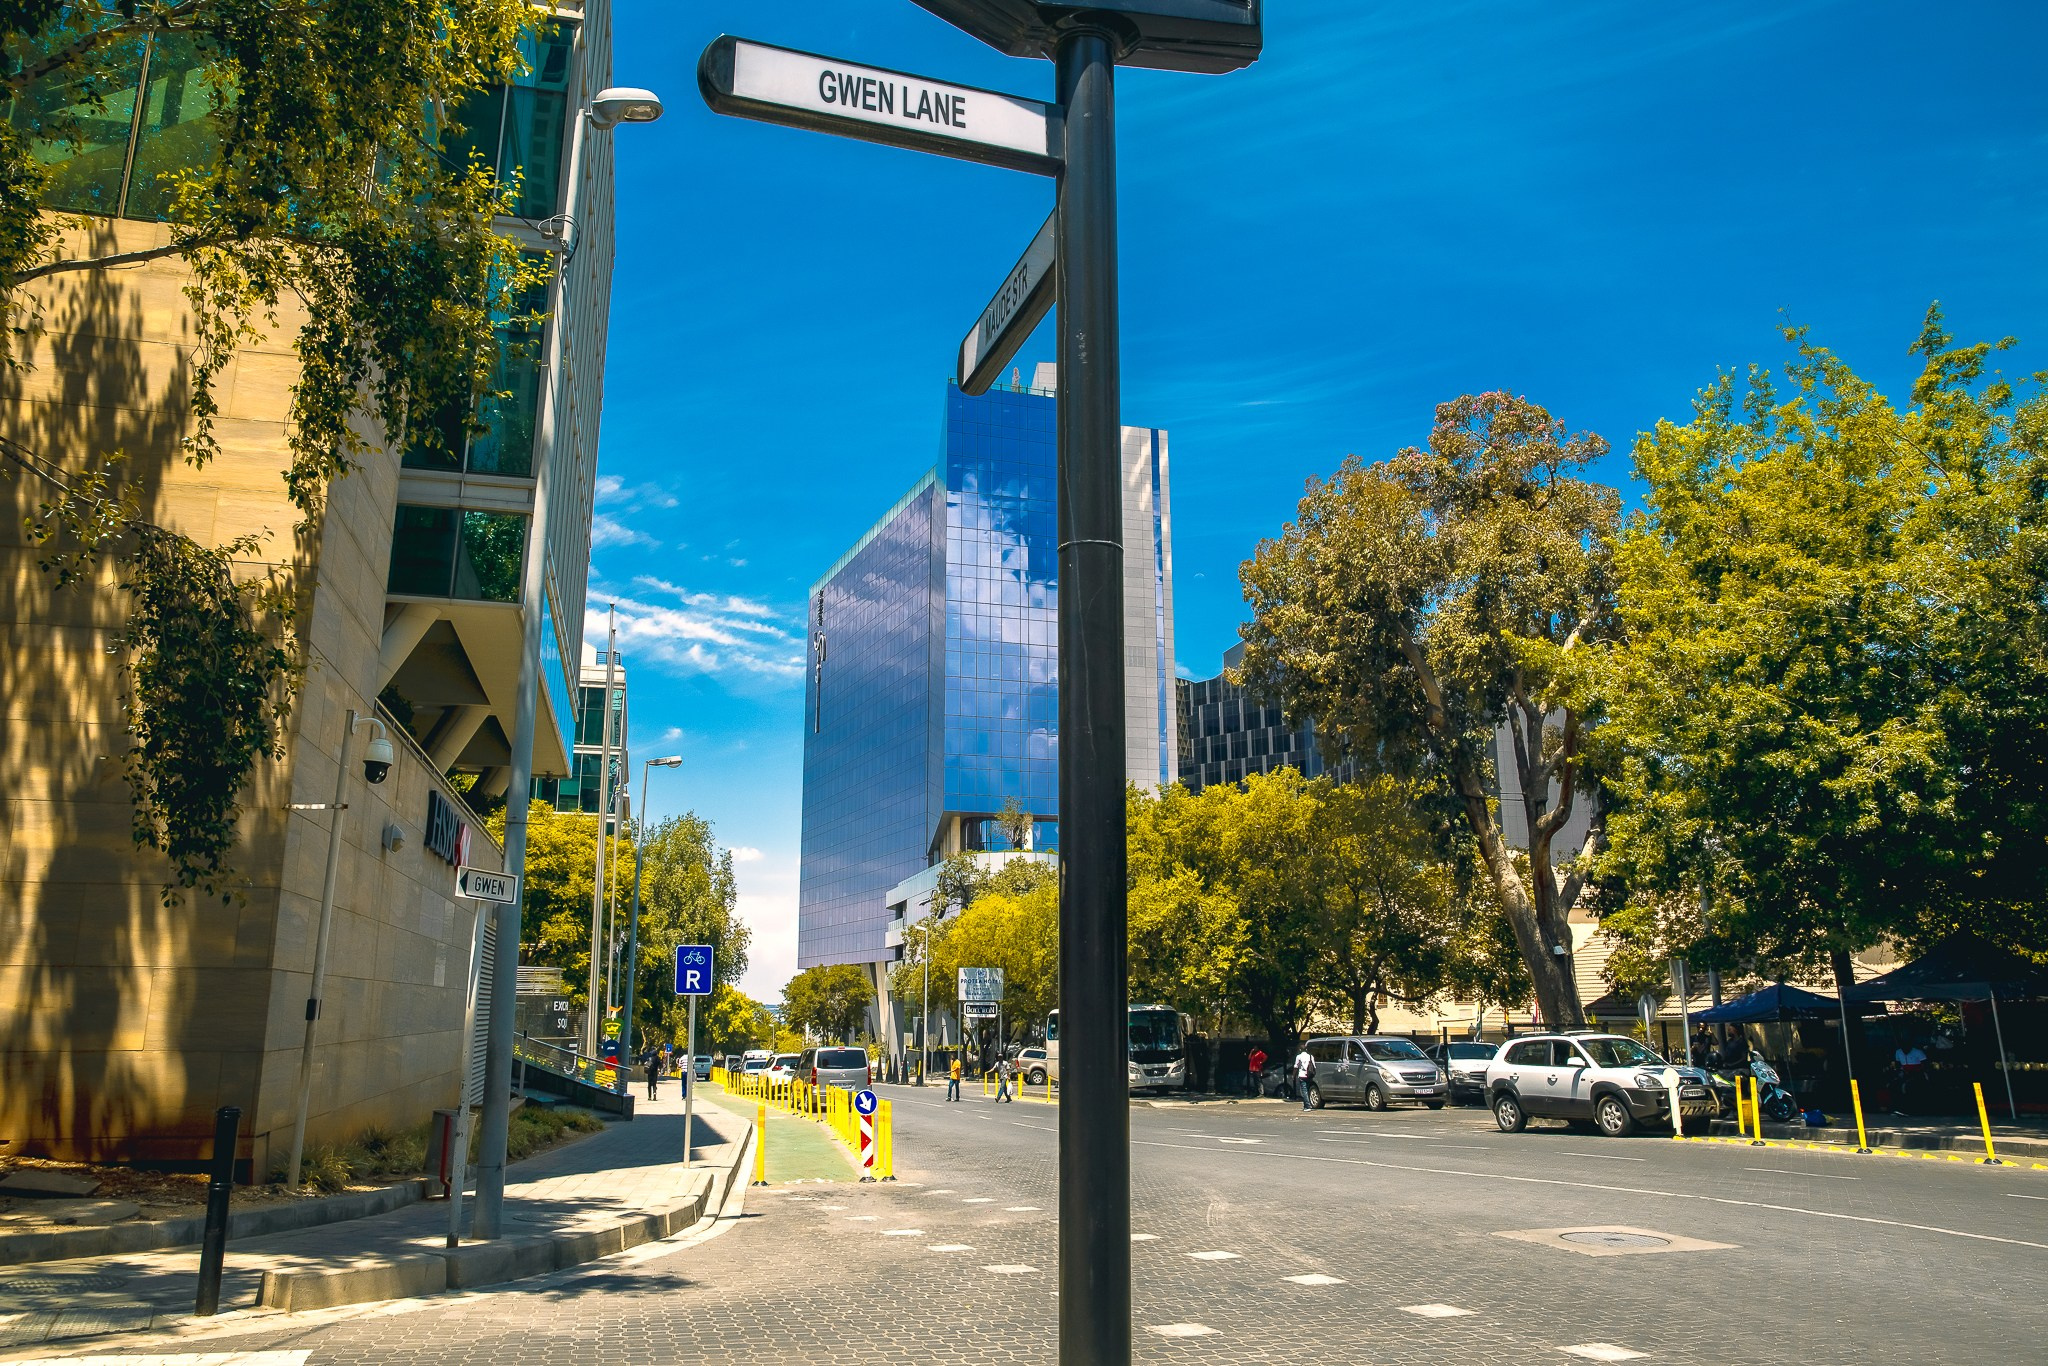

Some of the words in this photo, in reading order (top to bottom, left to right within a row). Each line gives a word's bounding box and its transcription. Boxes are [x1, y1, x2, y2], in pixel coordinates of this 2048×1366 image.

[818, 70, 894, 115] GWEN
[902, 86, 966, 128] LANE
[984, 286, 1012, 346] MAUDE
[1011, 262, 1029, 305] STR
[430, 793, 460, 867] HSBC
[474, 875, 506, 897] GWEN
[686, 969, 700, 989] R
